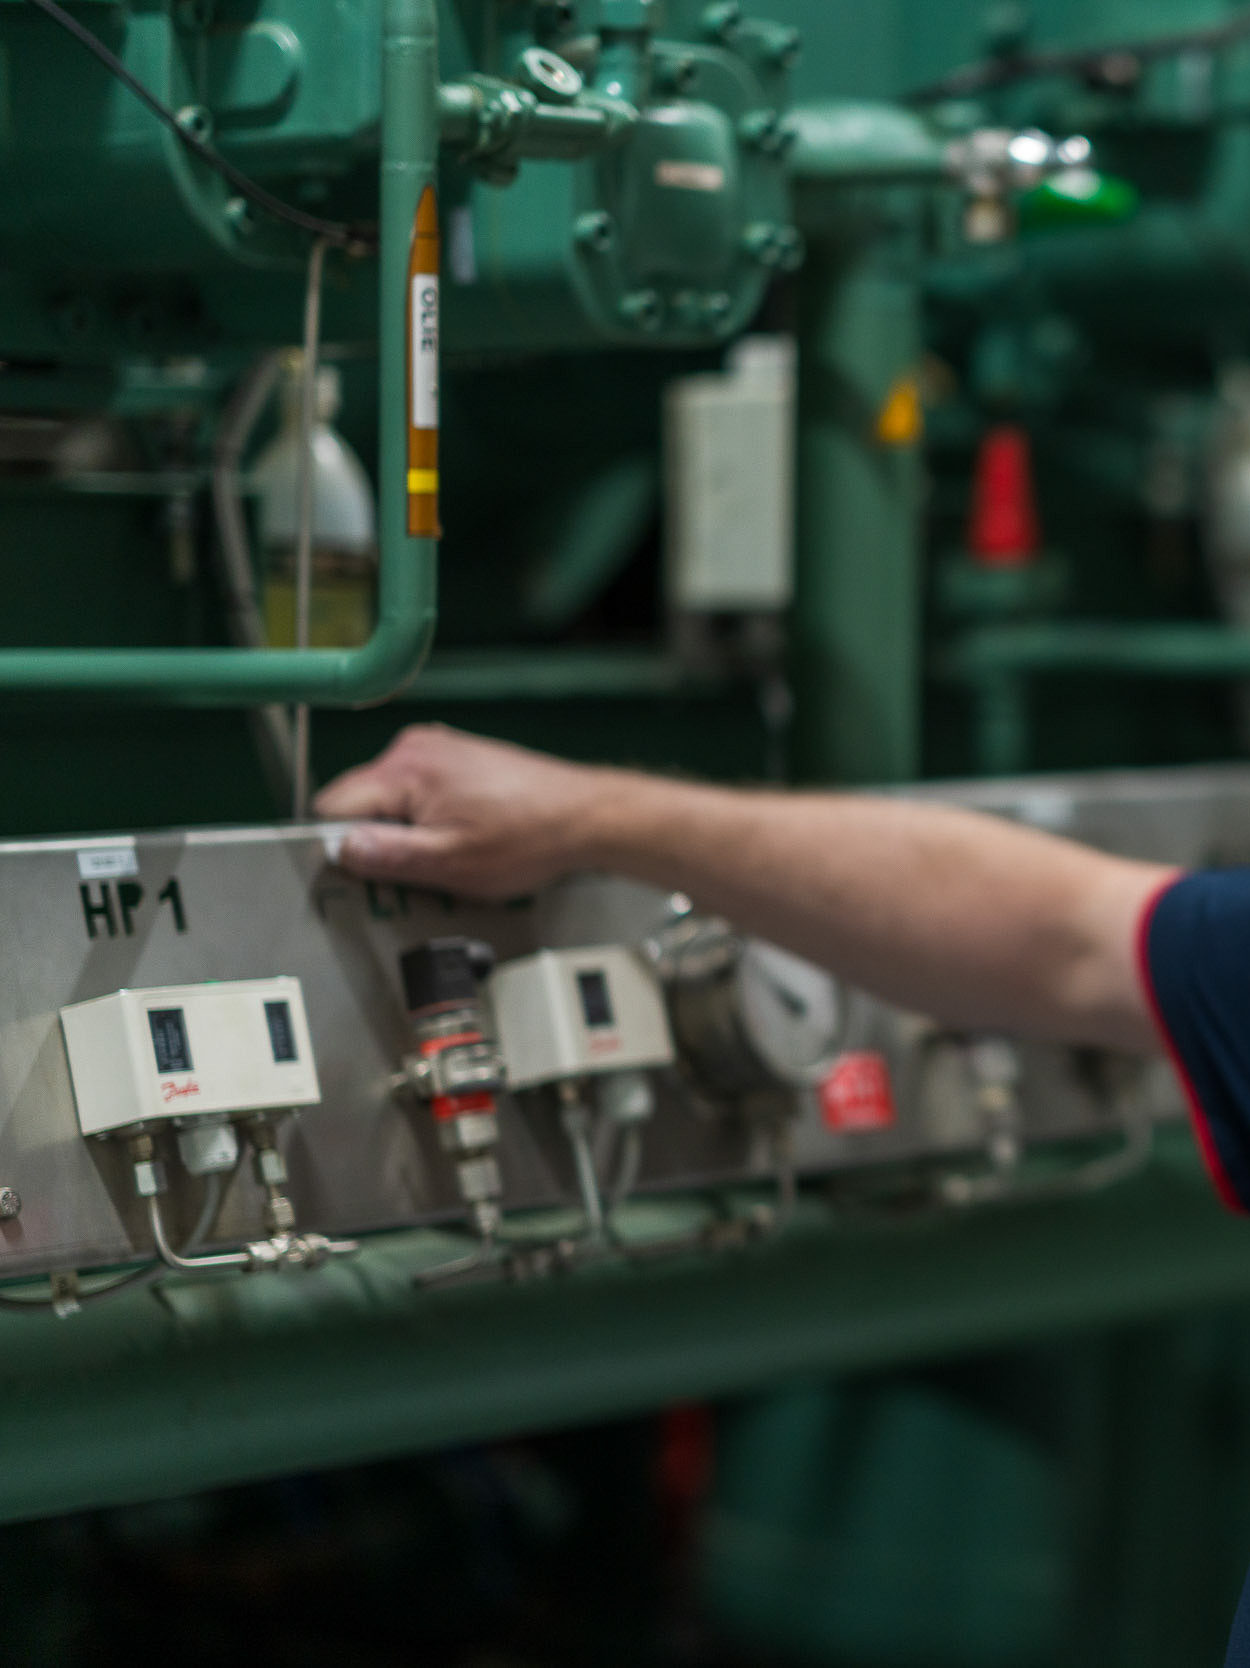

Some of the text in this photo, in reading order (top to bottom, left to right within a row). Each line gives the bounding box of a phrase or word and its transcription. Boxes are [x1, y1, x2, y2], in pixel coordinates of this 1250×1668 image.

[420, 287, 438, 352] OLIE
[80, 876, 187, 938] HP 1
